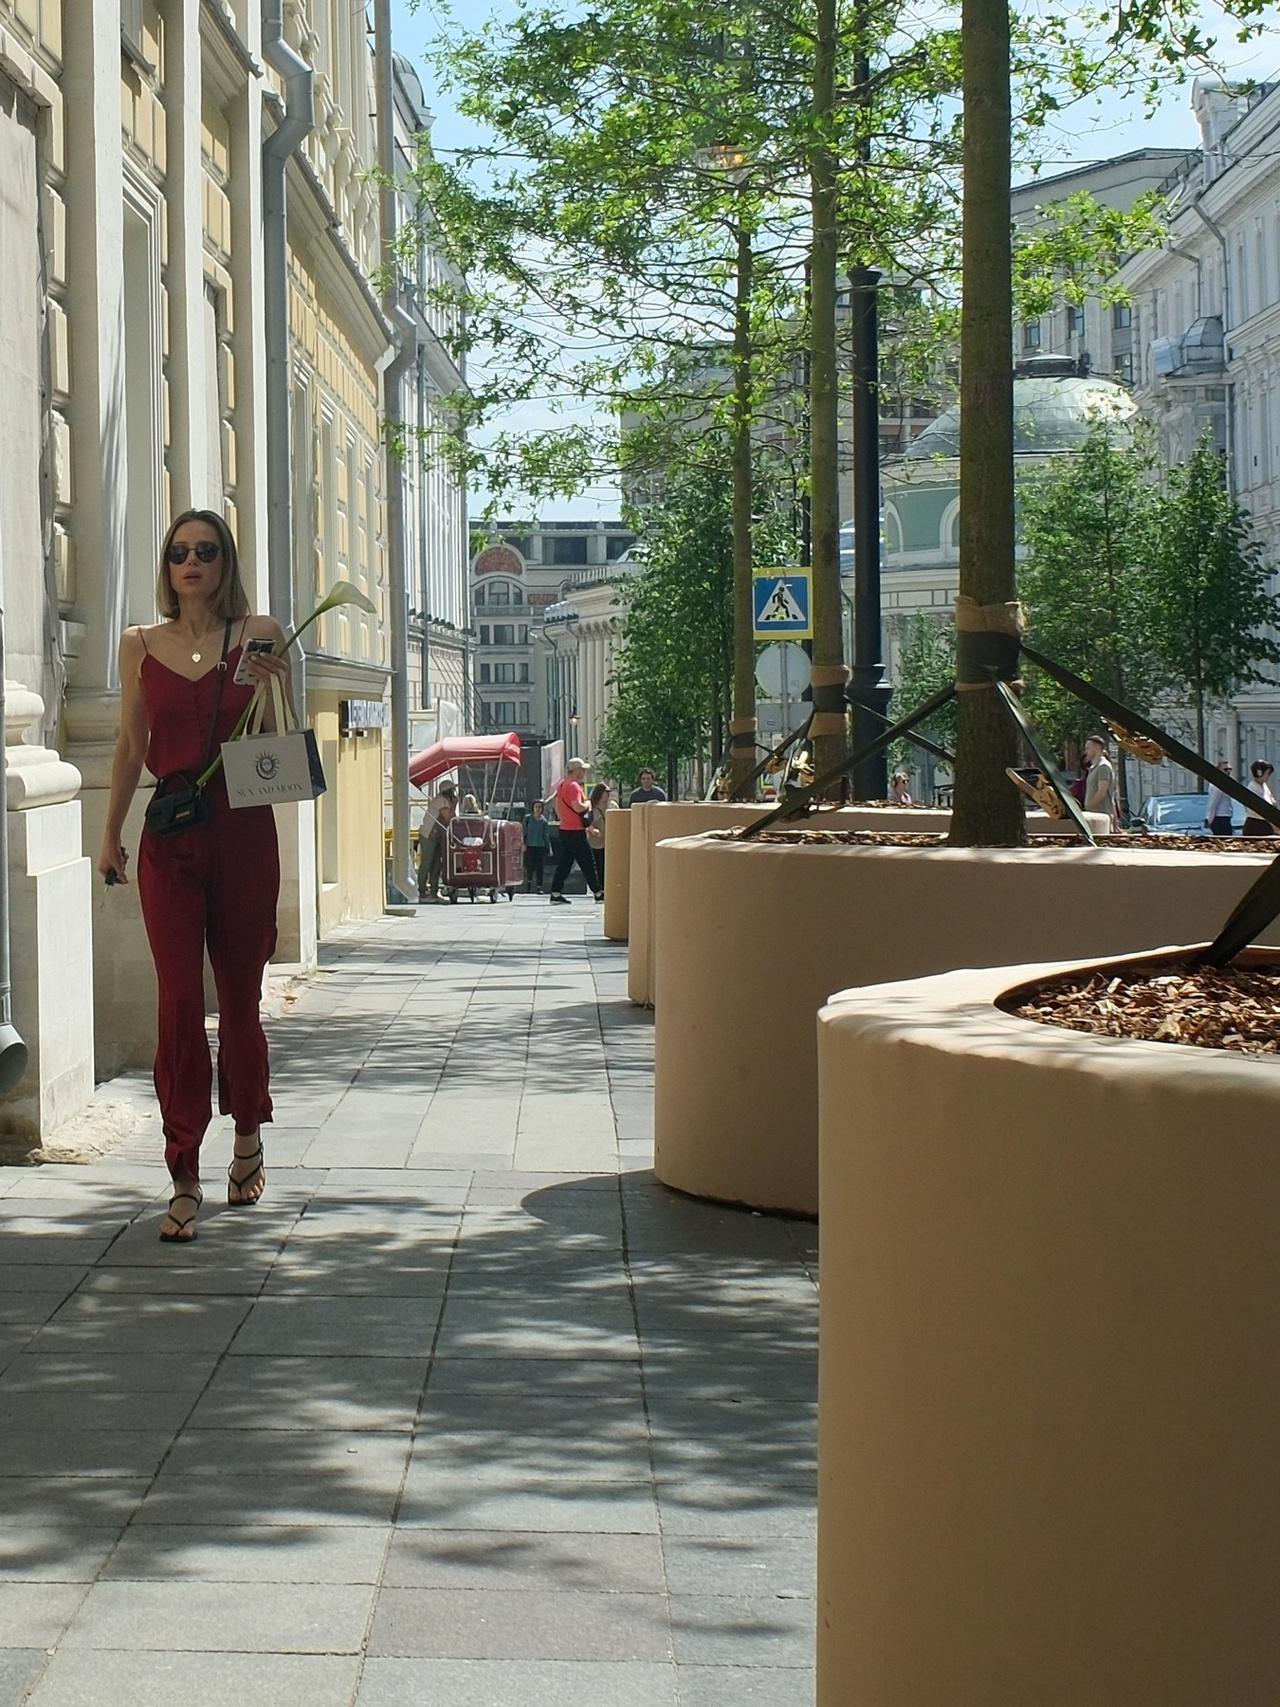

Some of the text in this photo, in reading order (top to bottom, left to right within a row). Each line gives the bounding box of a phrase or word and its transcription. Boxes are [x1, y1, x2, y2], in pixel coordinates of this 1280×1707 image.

[236, 783, 303, 797] SUN AND MOON
